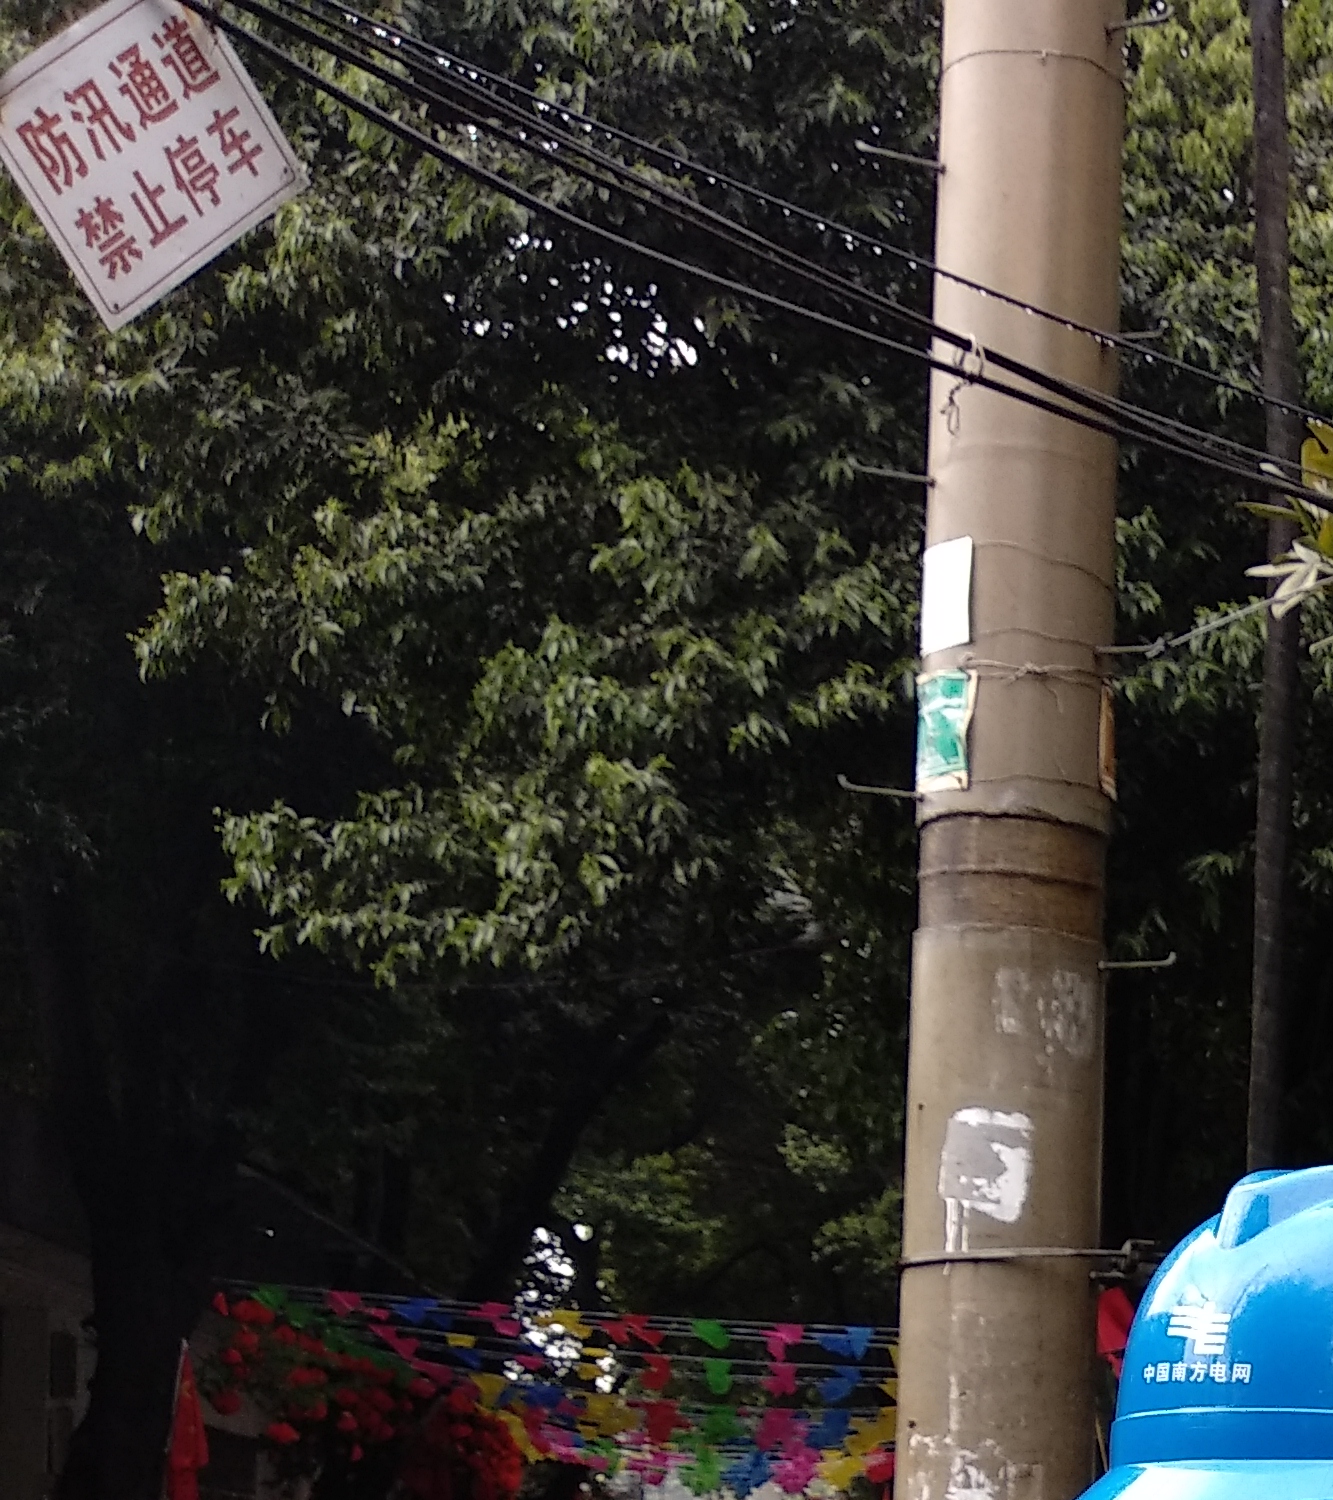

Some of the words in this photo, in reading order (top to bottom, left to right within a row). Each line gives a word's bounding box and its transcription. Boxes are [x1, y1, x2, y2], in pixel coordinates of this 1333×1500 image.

[15, 15, 221, 196] 防汛通道
[74, 106, 264, 280] 禁止停车
[1143, 1361, 1252, 1384] 中国南方电网
